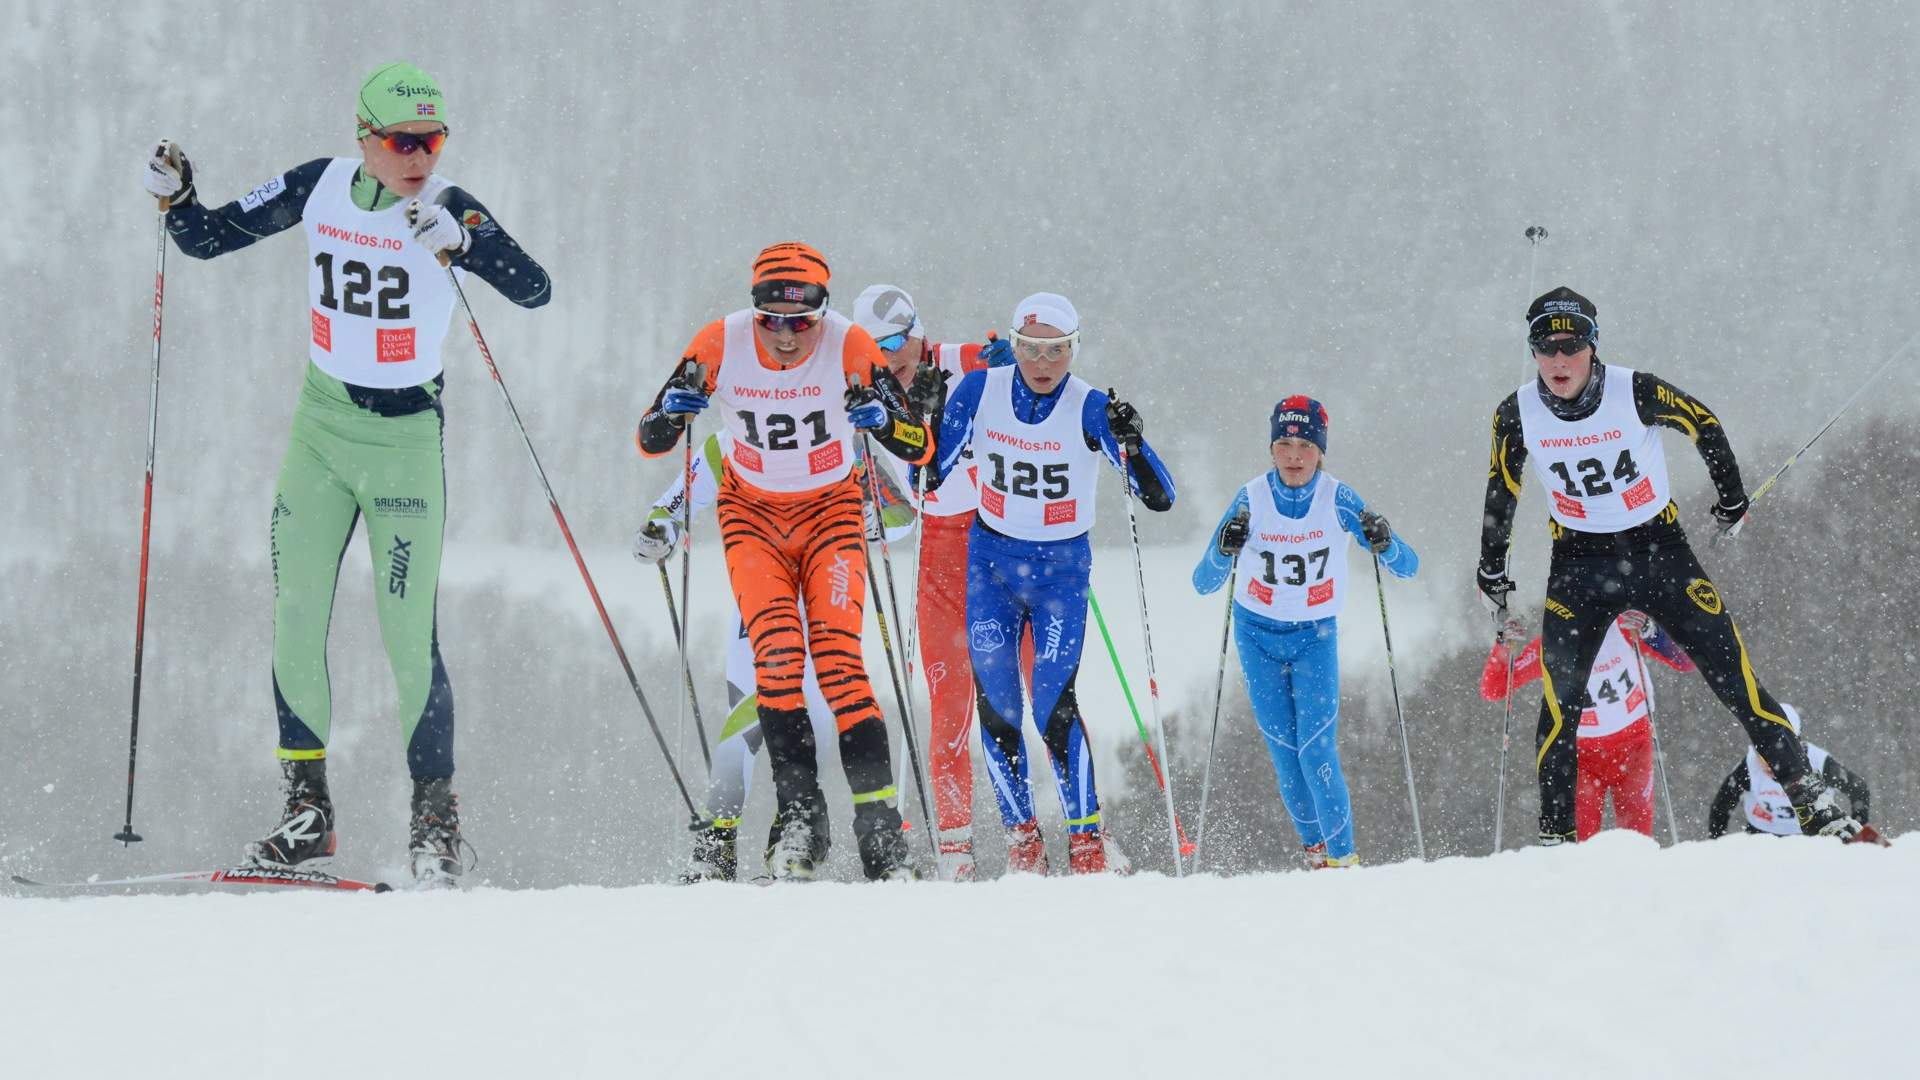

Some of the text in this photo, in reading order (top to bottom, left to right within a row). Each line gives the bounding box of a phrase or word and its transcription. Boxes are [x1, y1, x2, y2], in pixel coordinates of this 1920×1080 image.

[317, 223, 403, 251] www.tos.no
[314, 251, 411, 320] 122
[1551, 318, 1574, 331] RIL
[381, 333, 412, 343] TOLGA
[382, 348, 412, 358] BANK
[734, 385, 822, 400] www.tos.no
[1656, 384, 1675, 408] RIL
[736, 409, 832, 450] 121
[986, 429, 1062, 451] www.tos.no
[1540, 429, 1622, 448] www.tos.no
[987, 453, 1069, 500] 125
[1549, 448, 1641, 497] 124
[1259, 546, 1330, 586] 137
